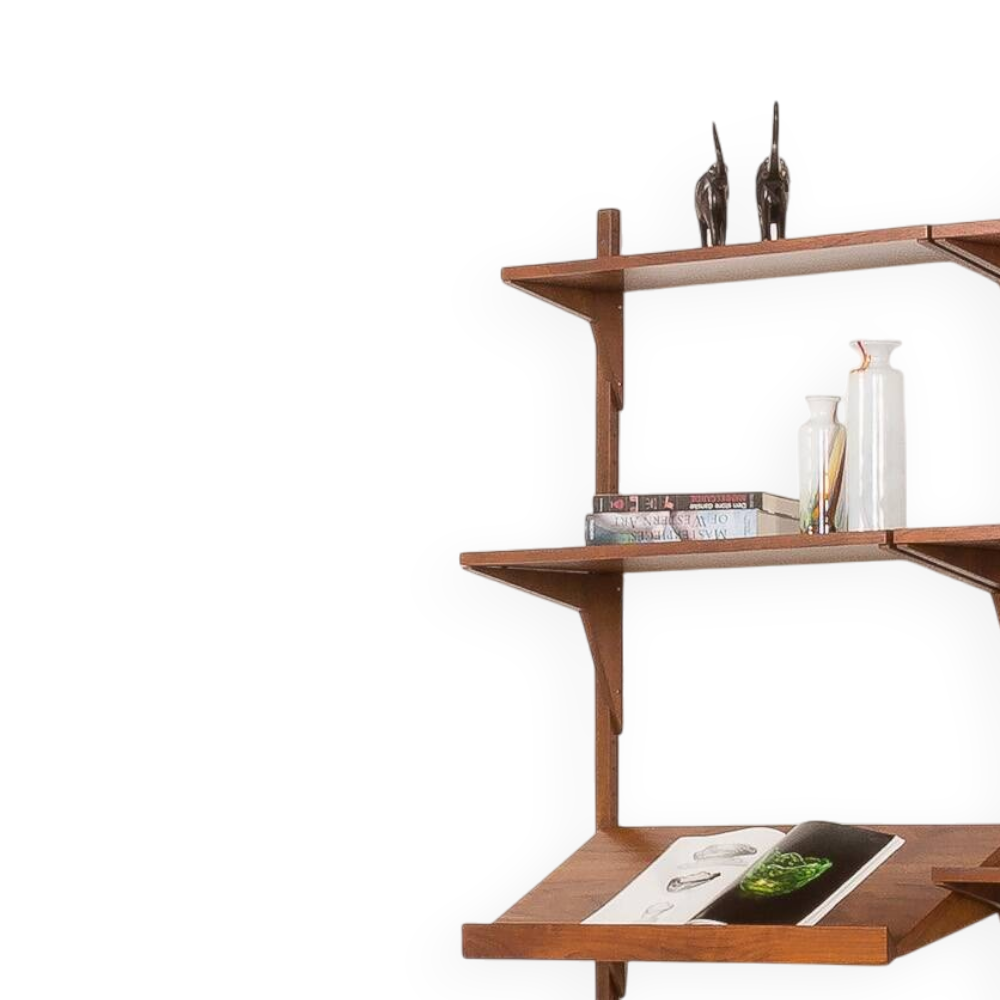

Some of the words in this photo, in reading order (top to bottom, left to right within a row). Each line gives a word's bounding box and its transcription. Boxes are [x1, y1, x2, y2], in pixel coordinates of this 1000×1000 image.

[614, 516, 638, 529] ART
[640, 514, 707, 527] WESTERN
[710, 515, 728, 525] OF
